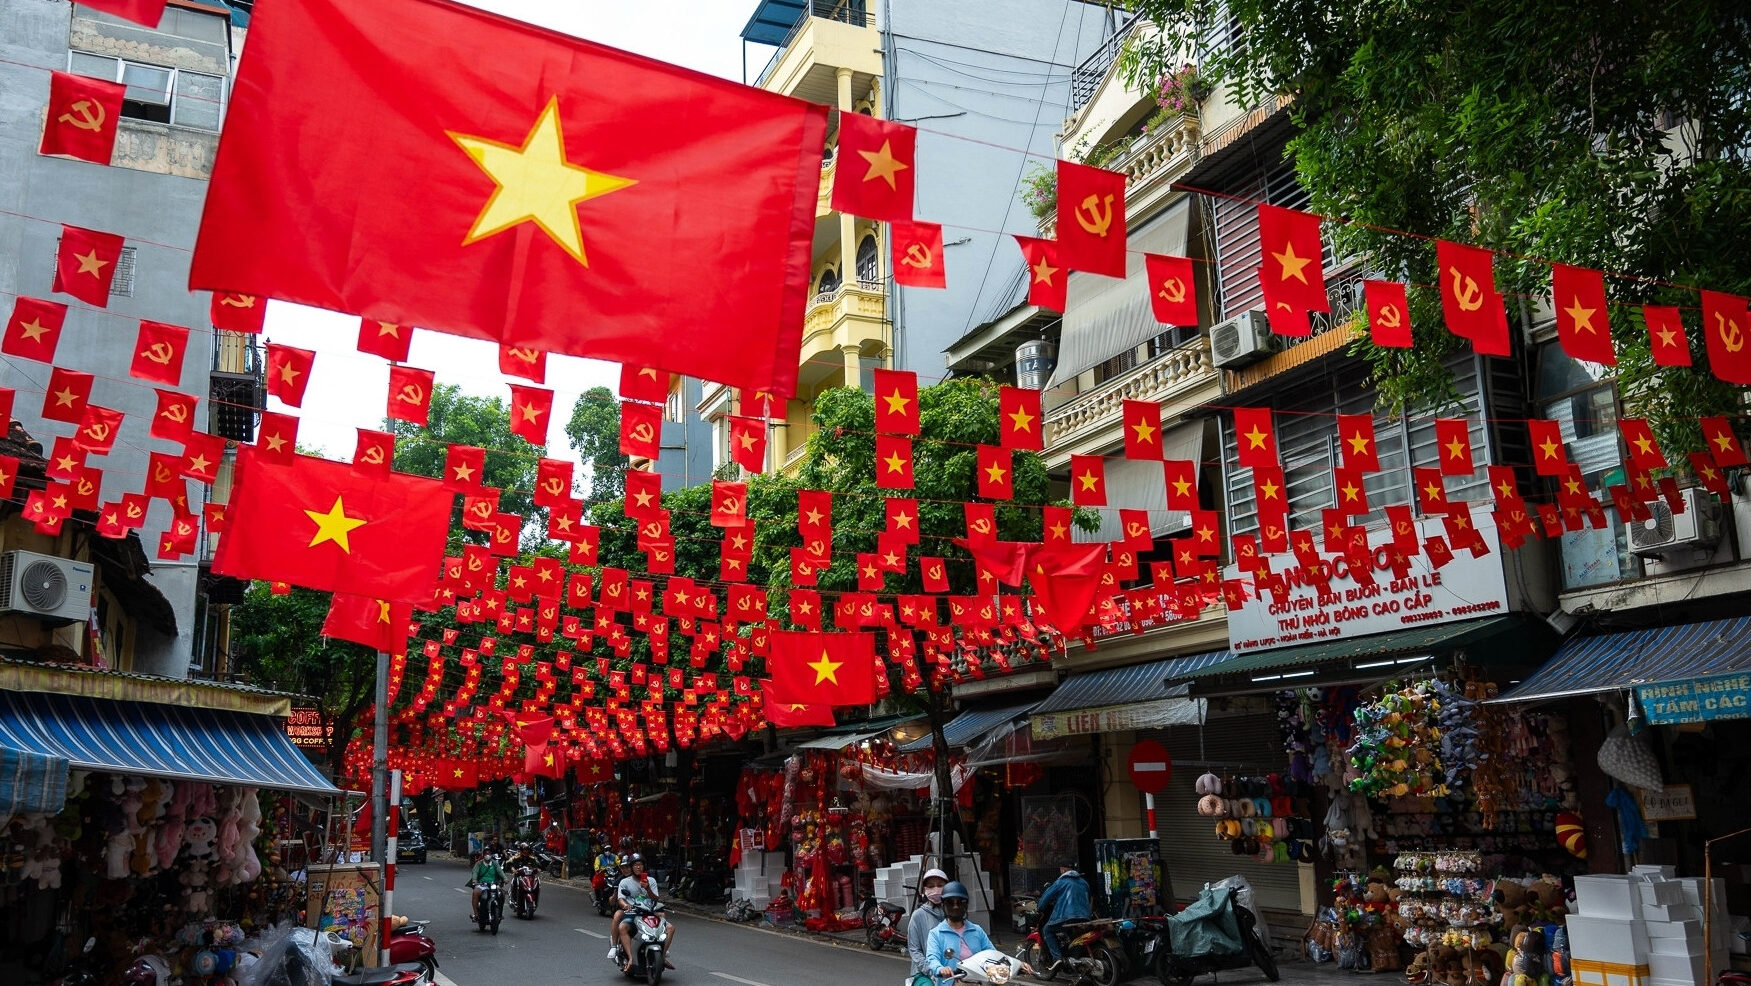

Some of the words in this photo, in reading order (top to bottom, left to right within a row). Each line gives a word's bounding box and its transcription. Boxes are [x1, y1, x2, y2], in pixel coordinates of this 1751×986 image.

[1278, 614, 1300, 631] THÚ
[1302, 608, 1330, 626] NHỒI
[1333, 605, 1369, 623] BÔNG
[1372, 600, 1400, 616] CAO
[1404, 590, 1432, 611] CẤP
[288, 711, 322, 724] COFF
[1066, 710, 1100, 734] LIÊN
[287, 726, 334, 737] WORKSHP
